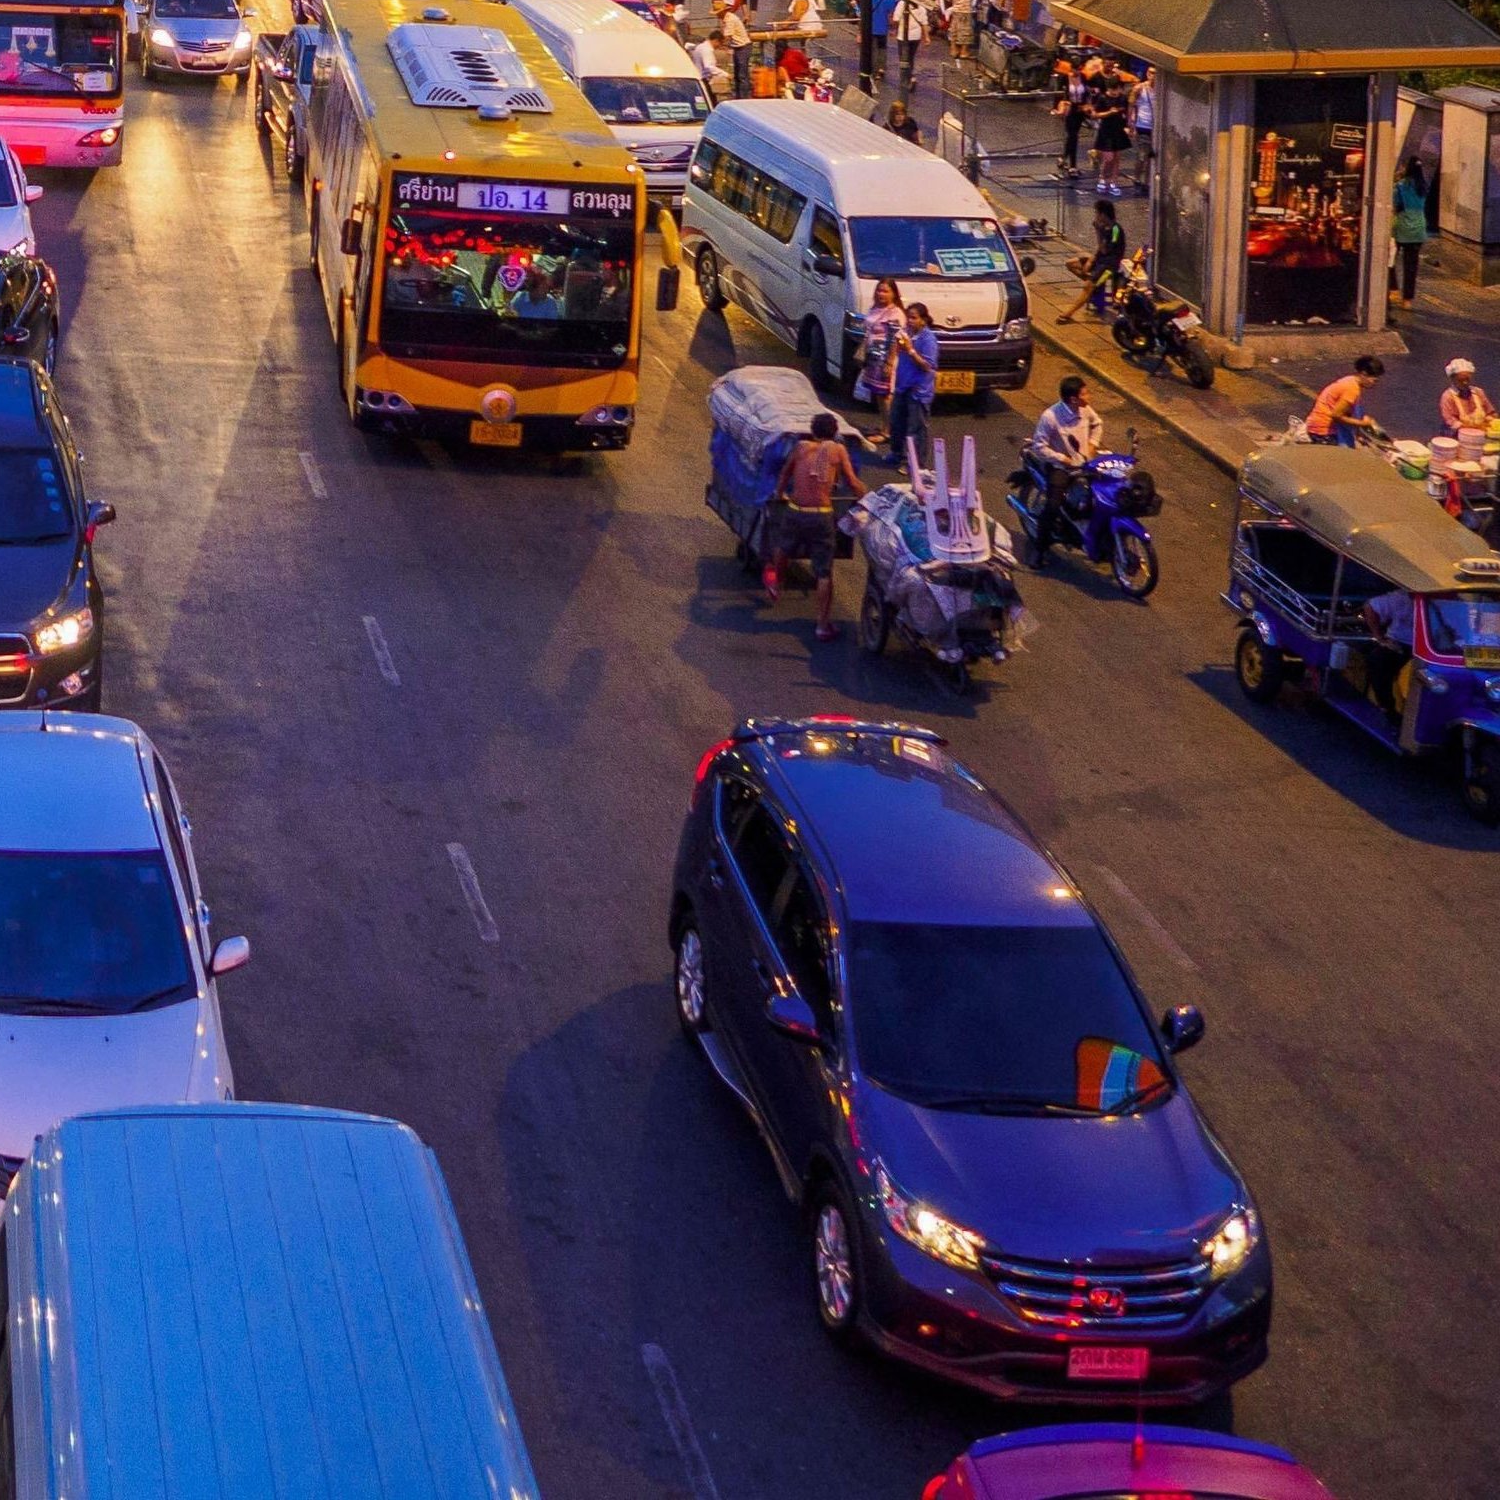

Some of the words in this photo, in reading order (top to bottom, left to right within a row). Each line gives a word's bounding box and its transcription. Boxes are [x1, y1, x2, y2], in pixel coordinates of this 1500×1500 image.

[399, 179, 455, 202] ศรีย่าน
[478, 185, 514, 208] ปอ.
[522, 190, 548, 211] 14
[572, 191, 632, 218] สวนลุม
